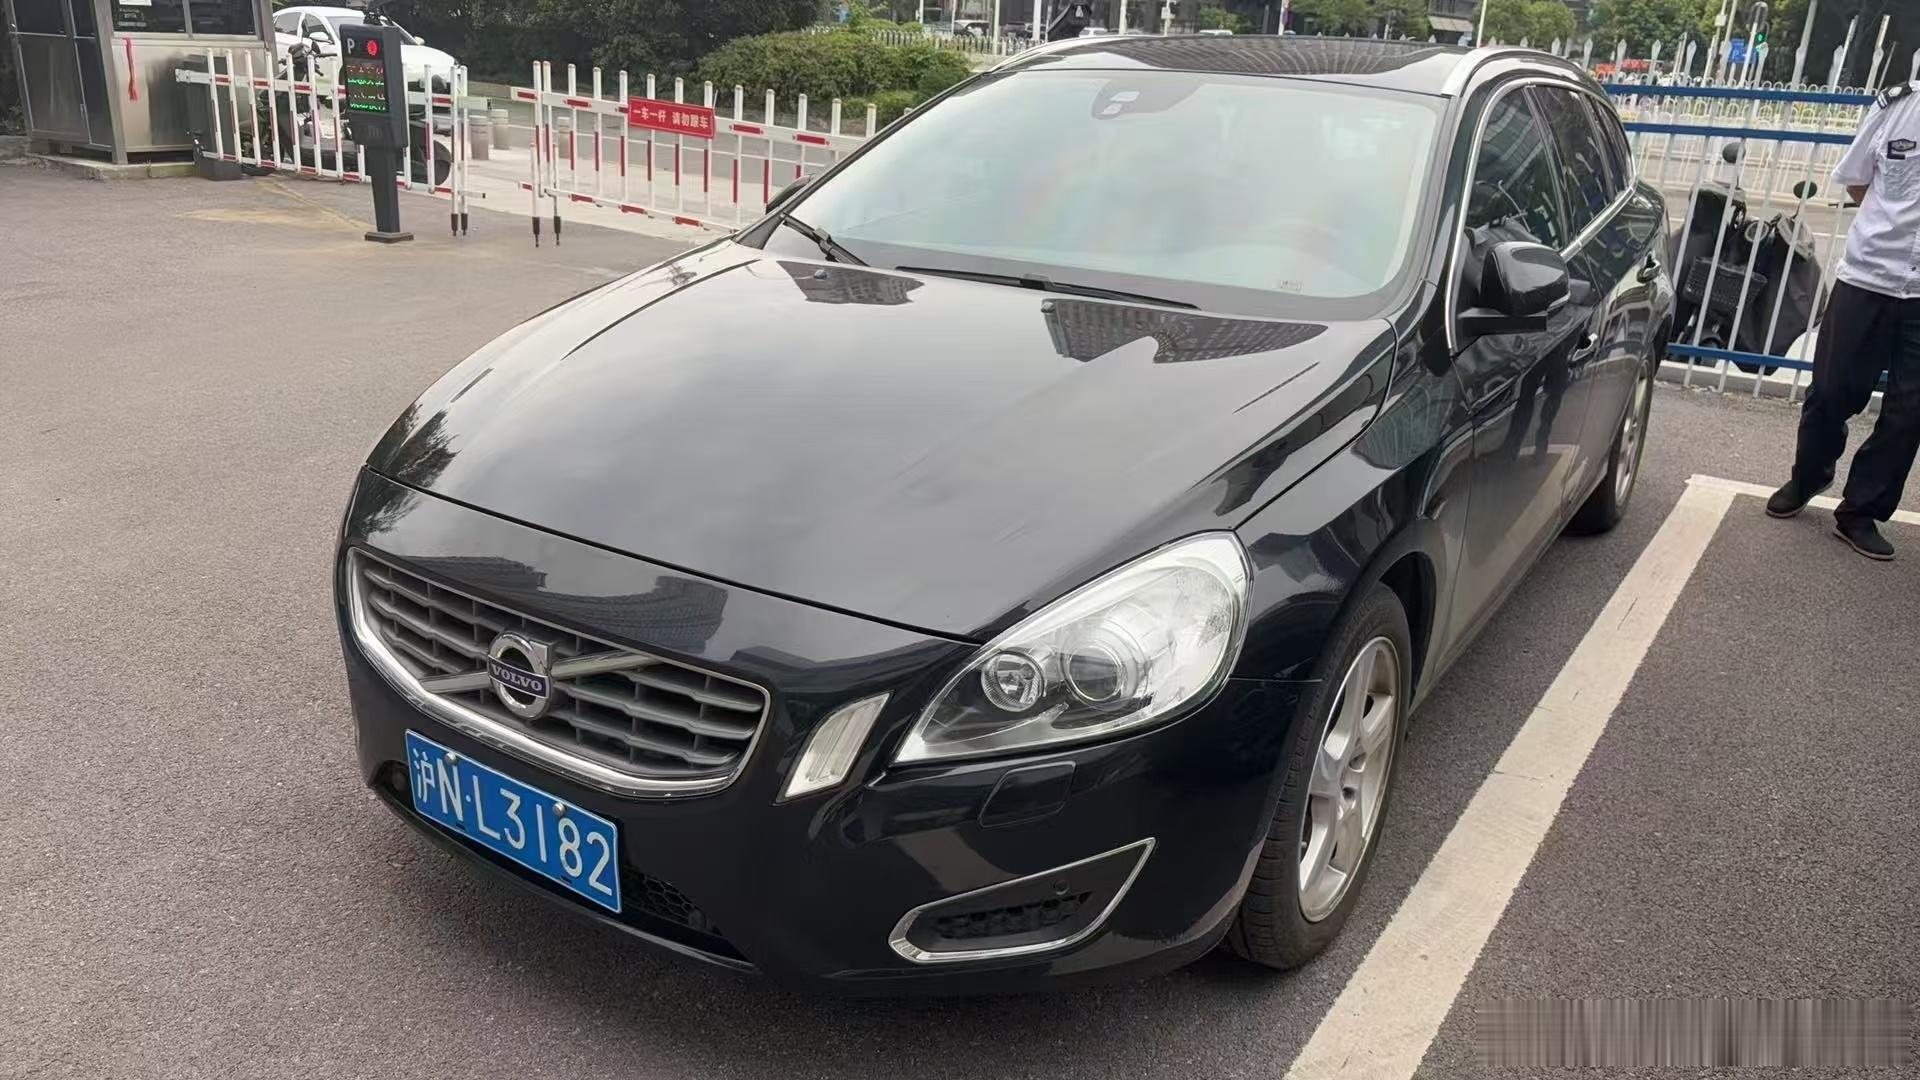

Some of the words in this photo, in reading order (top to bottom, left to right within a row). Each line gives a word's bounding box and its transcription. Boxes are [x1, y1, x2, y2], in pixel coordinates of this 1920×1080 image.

[346, 38, 355, 54] P
[632, 107, 666, 122] 一车一杆
[672, 111, 708, 128] 请勿跟车
[490, 662, 543, 691] VOLVO
